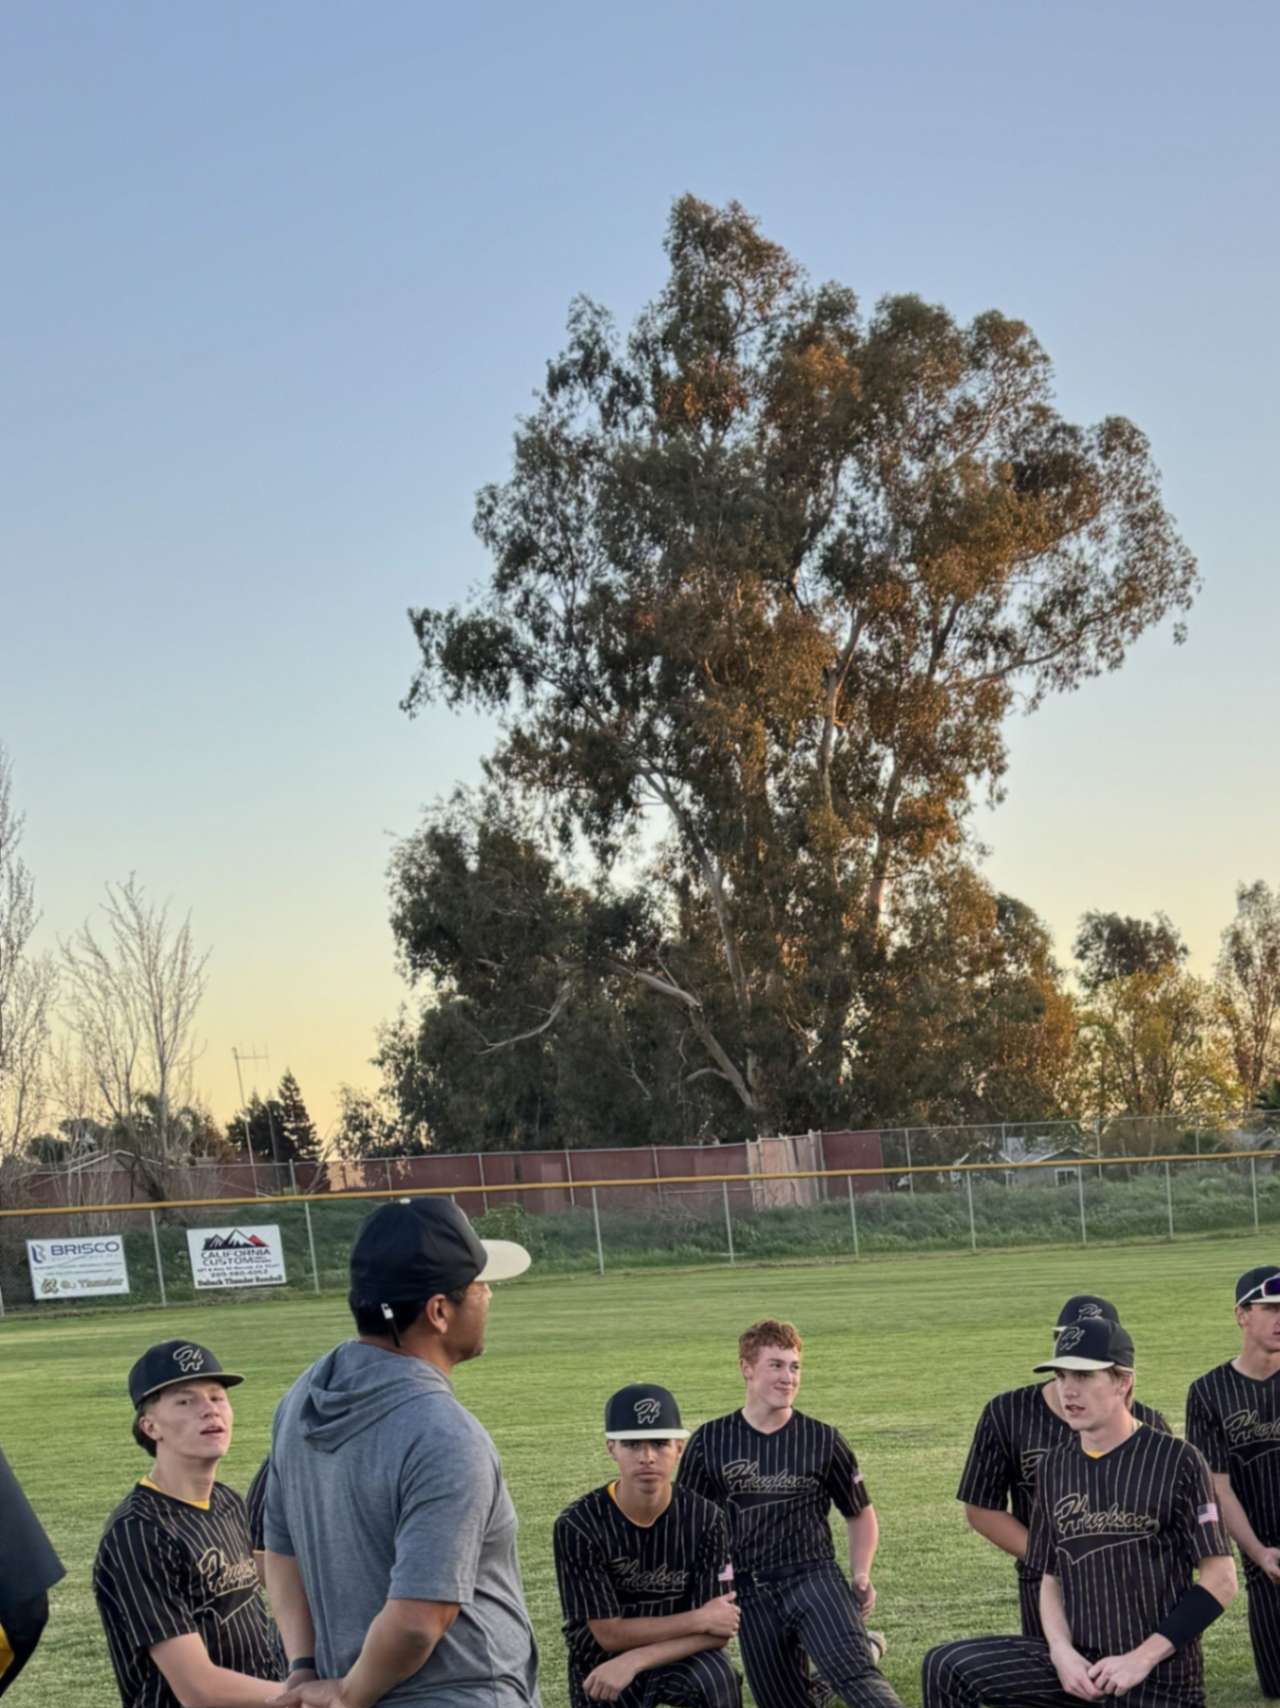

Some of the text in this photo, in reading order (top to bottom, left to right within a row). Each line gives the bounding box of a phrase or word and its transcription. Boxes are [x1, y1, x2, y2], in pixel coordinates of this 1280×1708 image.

[50, 1241, 120, 1256] BRISCO
[201, 1248, 271, 1260] CALIFORNIA
[202, 1256, 253, 1267] CUSTOM
[1054, 1493, 1159, 1534] Hughson
